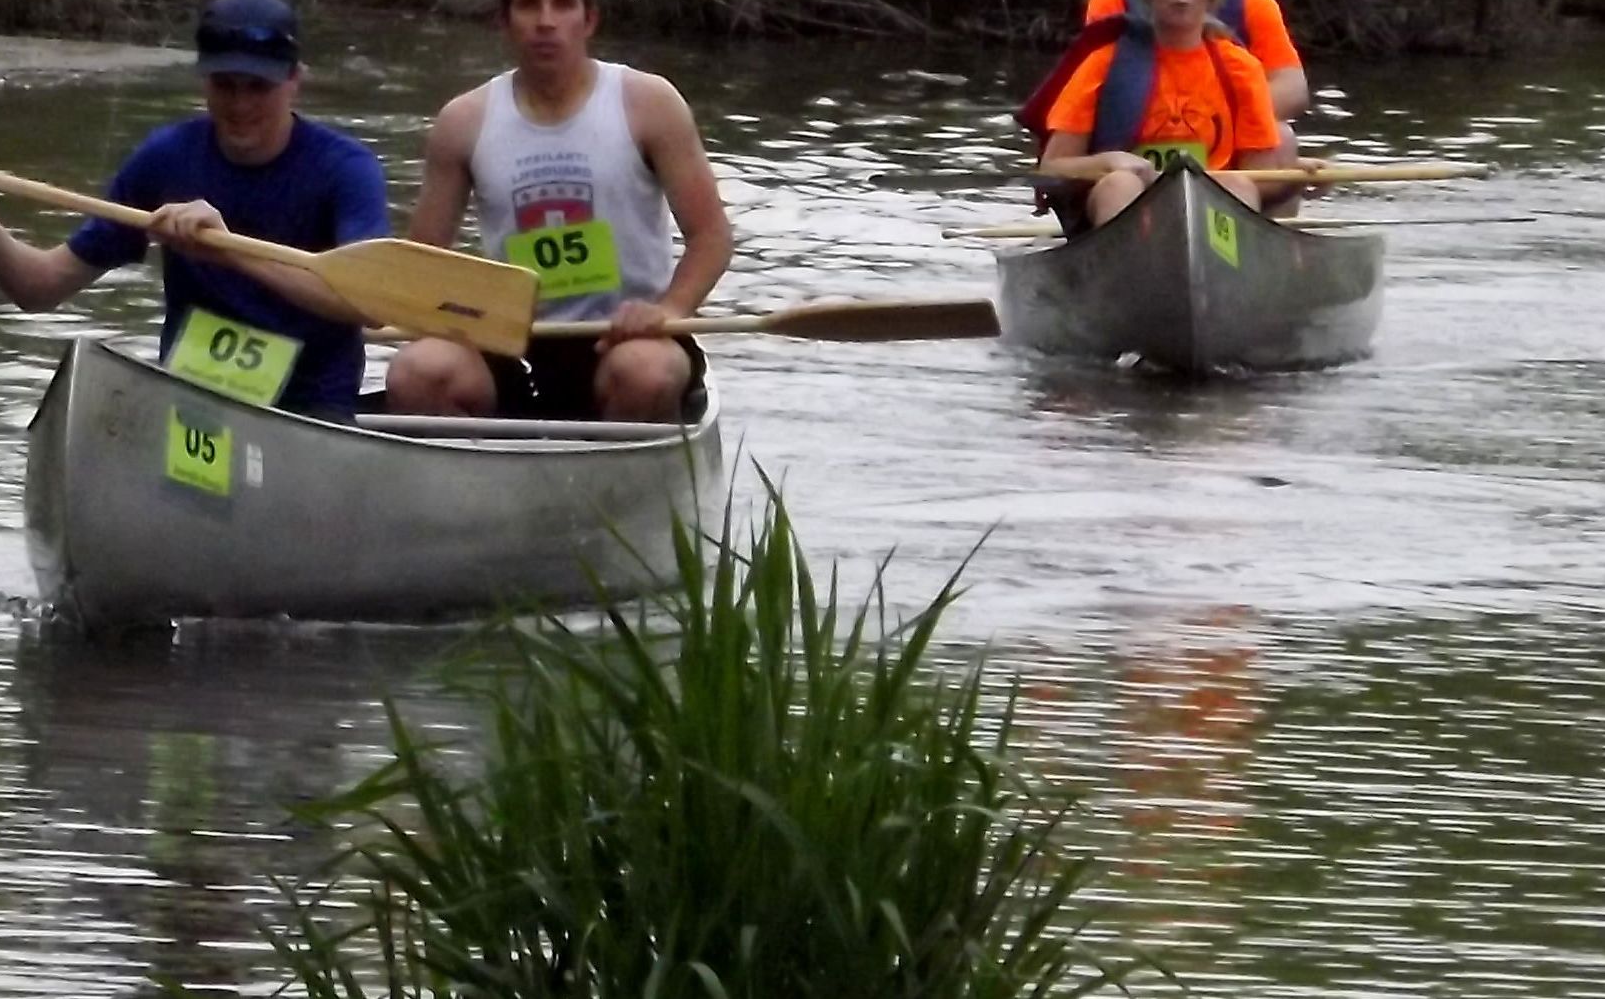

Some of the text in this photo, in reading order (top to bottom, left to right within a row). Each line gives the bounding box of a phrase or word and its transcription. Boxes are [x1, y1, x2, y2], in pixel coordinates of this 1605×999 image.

[533, 230, 590, 269] 05
[208, 326, 269, 371] 05
[184, 425, 216, 465] 05
